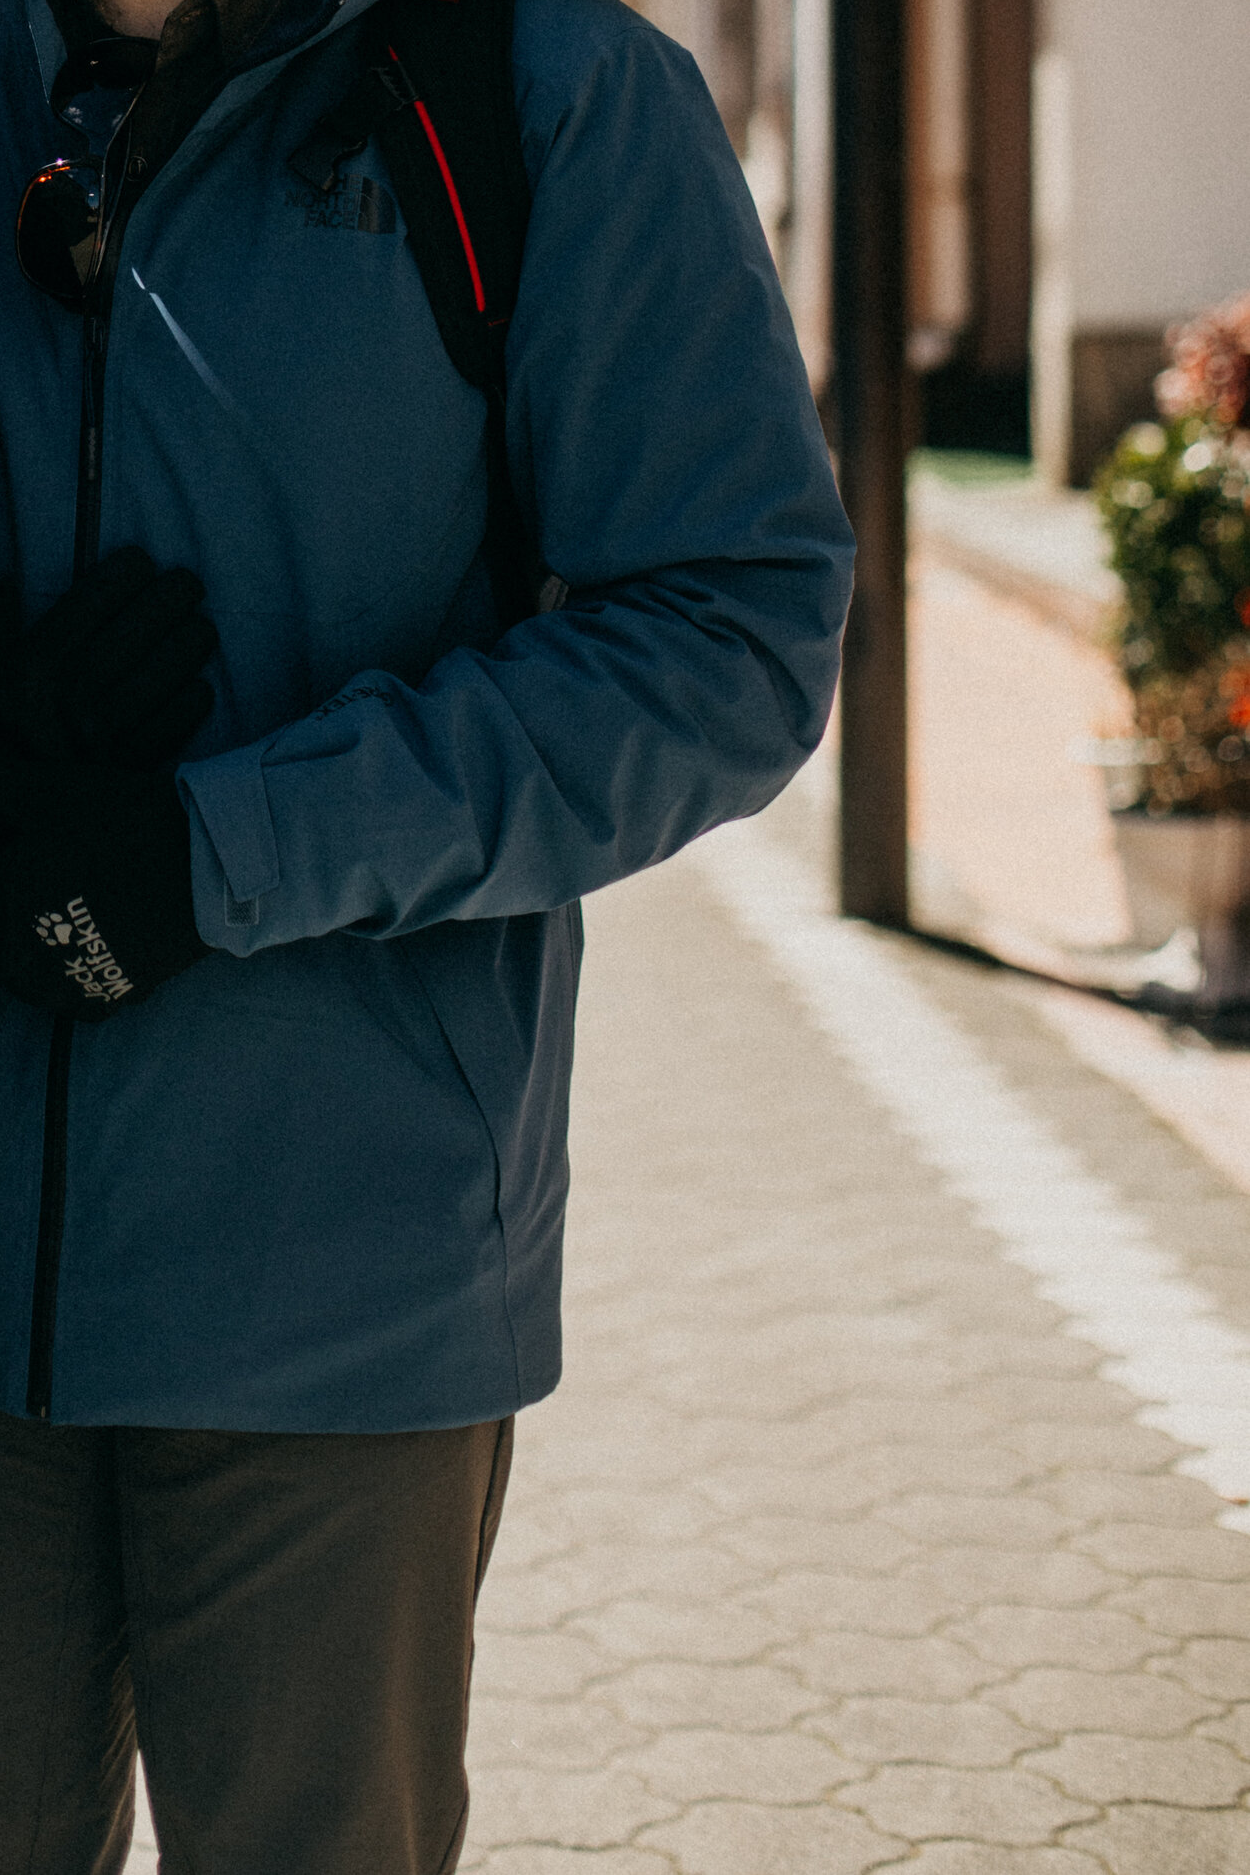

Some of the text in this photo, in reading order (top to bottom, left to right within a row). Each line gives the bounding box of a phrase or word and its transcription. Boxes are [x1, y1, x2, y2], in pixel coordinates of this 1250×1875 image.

[284, 190, 359, 211] NORTH
[303, 210, 358, 230] FACE
[67, 895, 134, 1000] Wolfskin
[64, 955, 111, 1002] Jack
